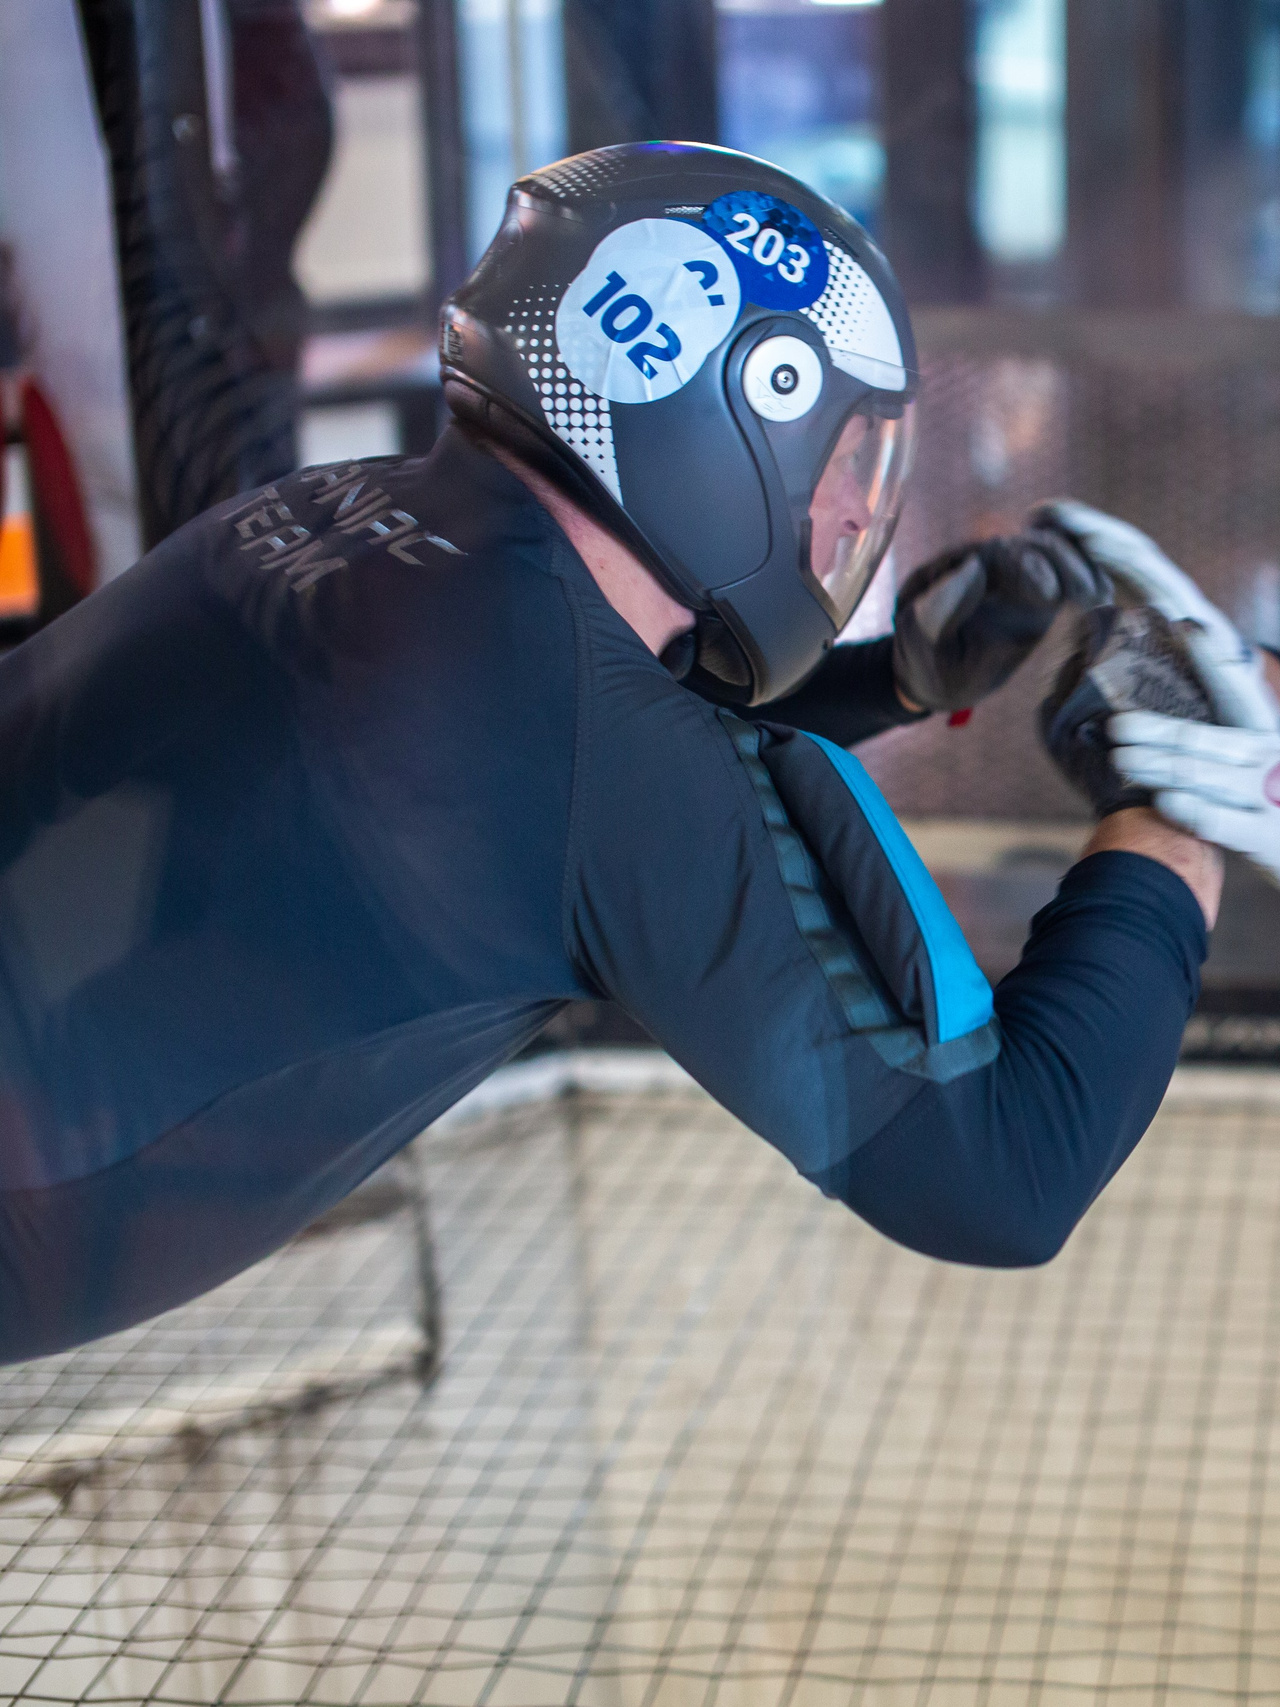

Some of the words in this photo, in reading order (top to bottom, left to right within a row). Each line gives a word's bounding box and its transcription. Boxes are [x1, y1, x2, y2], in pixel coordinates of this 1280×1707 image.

[725, 212, 811, 283] 203
[582, 270, 682, 381] 102
[219, 486, 349, 593] TEAM
